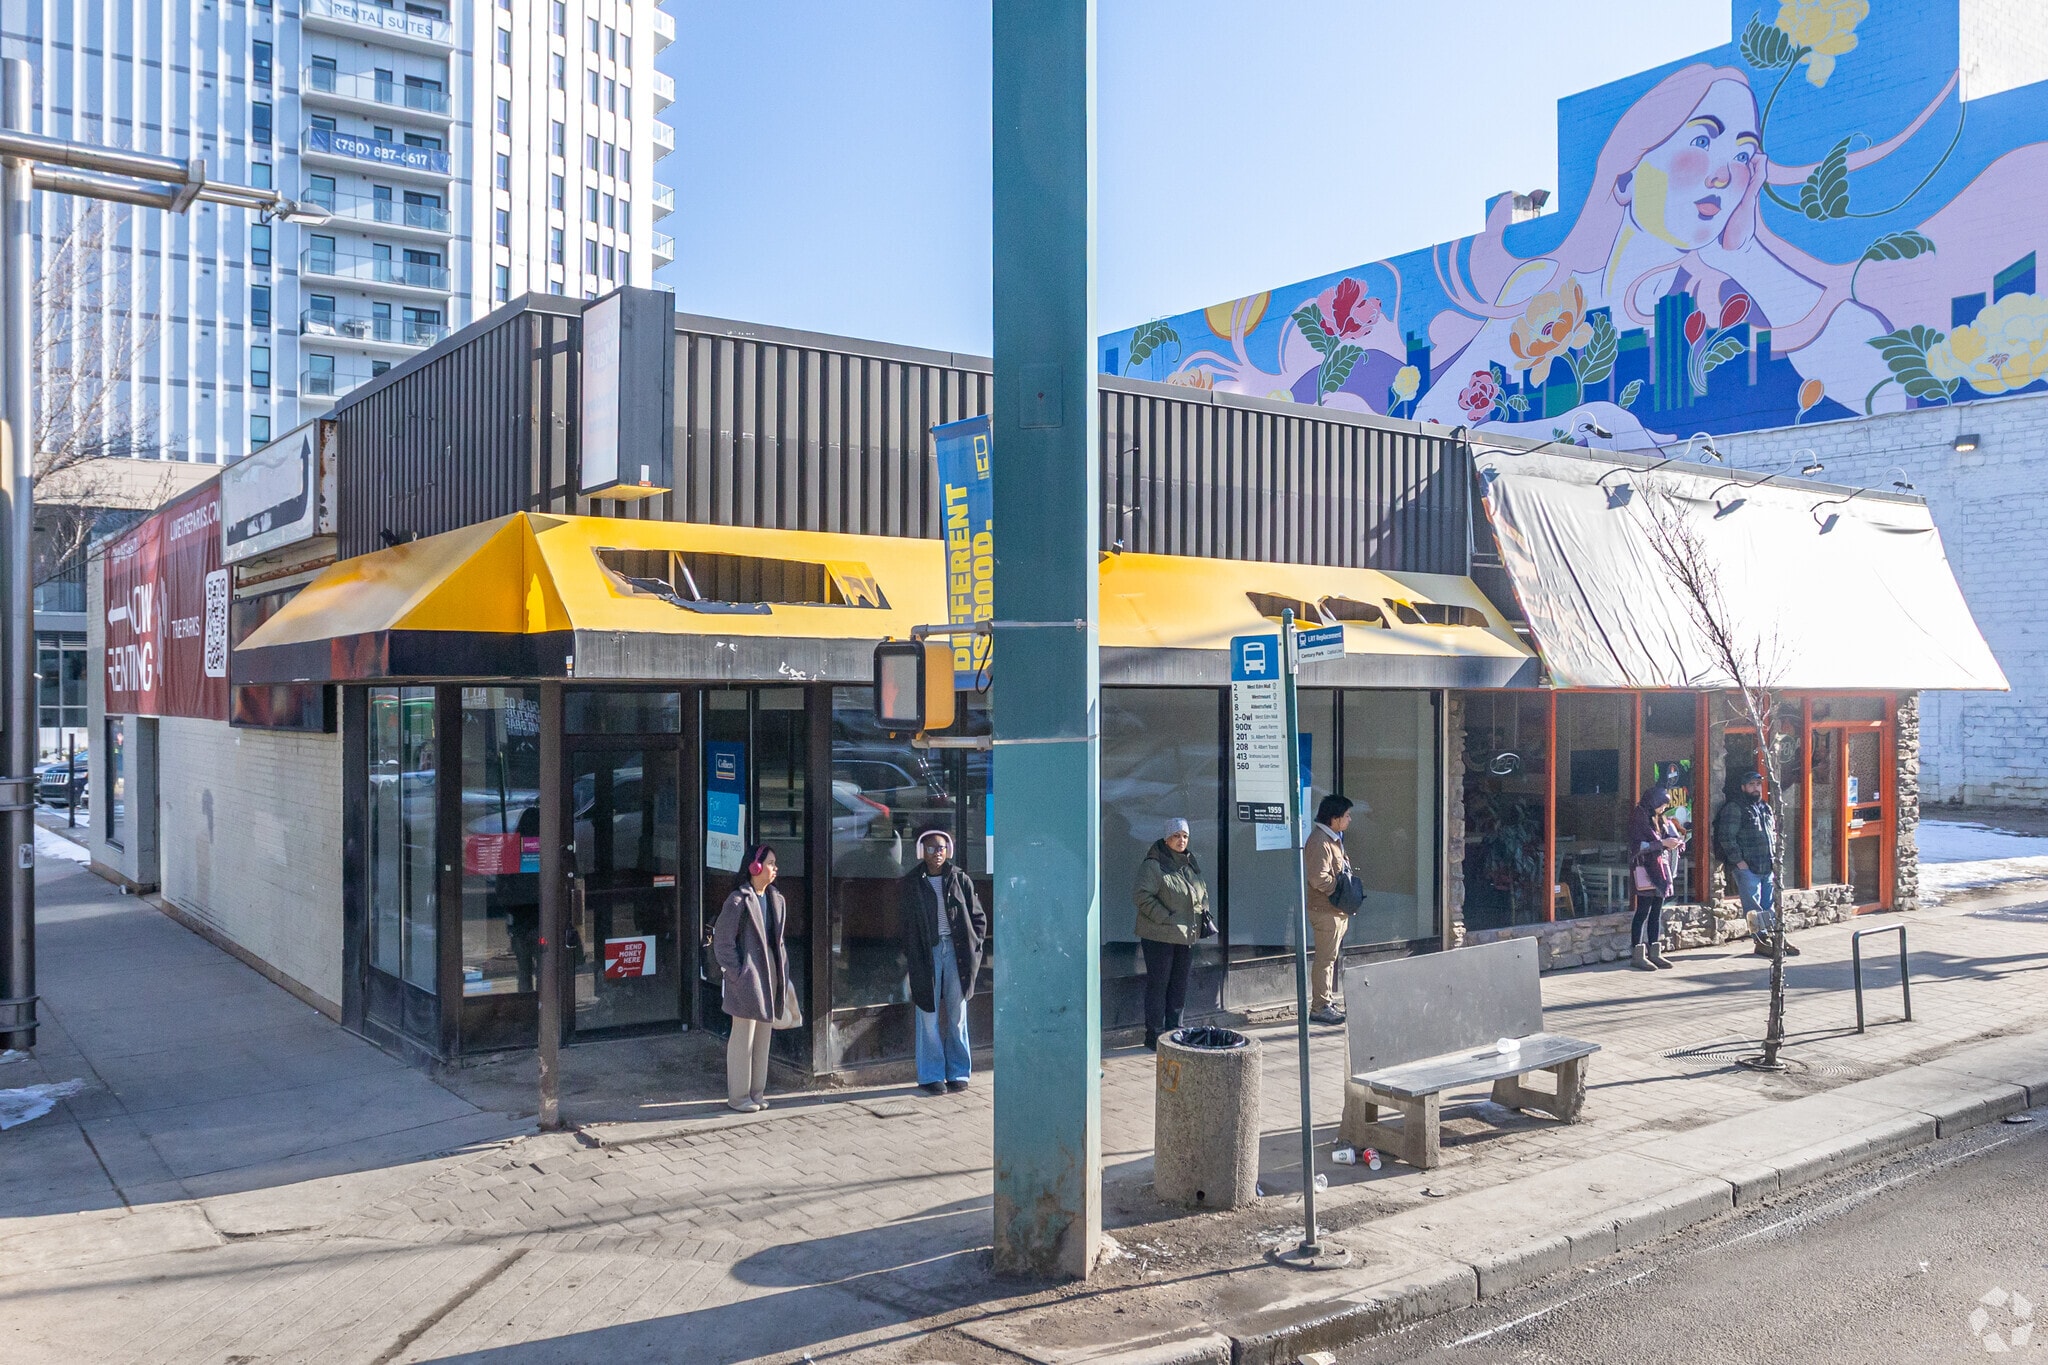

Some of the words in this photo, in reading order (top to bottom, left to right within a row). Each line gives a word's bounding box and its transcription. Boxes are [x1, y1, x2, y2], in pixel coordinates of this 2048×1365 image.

[333, 3, 383, 25] RENTAL
[387, 16, 432, 36] SUITES
[335, 138, 370, 155] (780)
[374, 147, 427, 165] 887-6617
[1233, 683, 1238, 691] 2
[1234, 693, 1239, 701] 5
[1234, 703, 1239, 711] 8
[1234, 713, 1253, 721] 2-Owl
[1236, 743, 1249, 751] 208
[1236, 752, 1248, 760] 413
[1236, 762, 1250, 770] 560
[1267, 806, 1282, 814] 1959
[624, 943, 643, 951] SEND
[618, 949, 642, 958] MONEY
[623, 956, 641, 964] HERE
